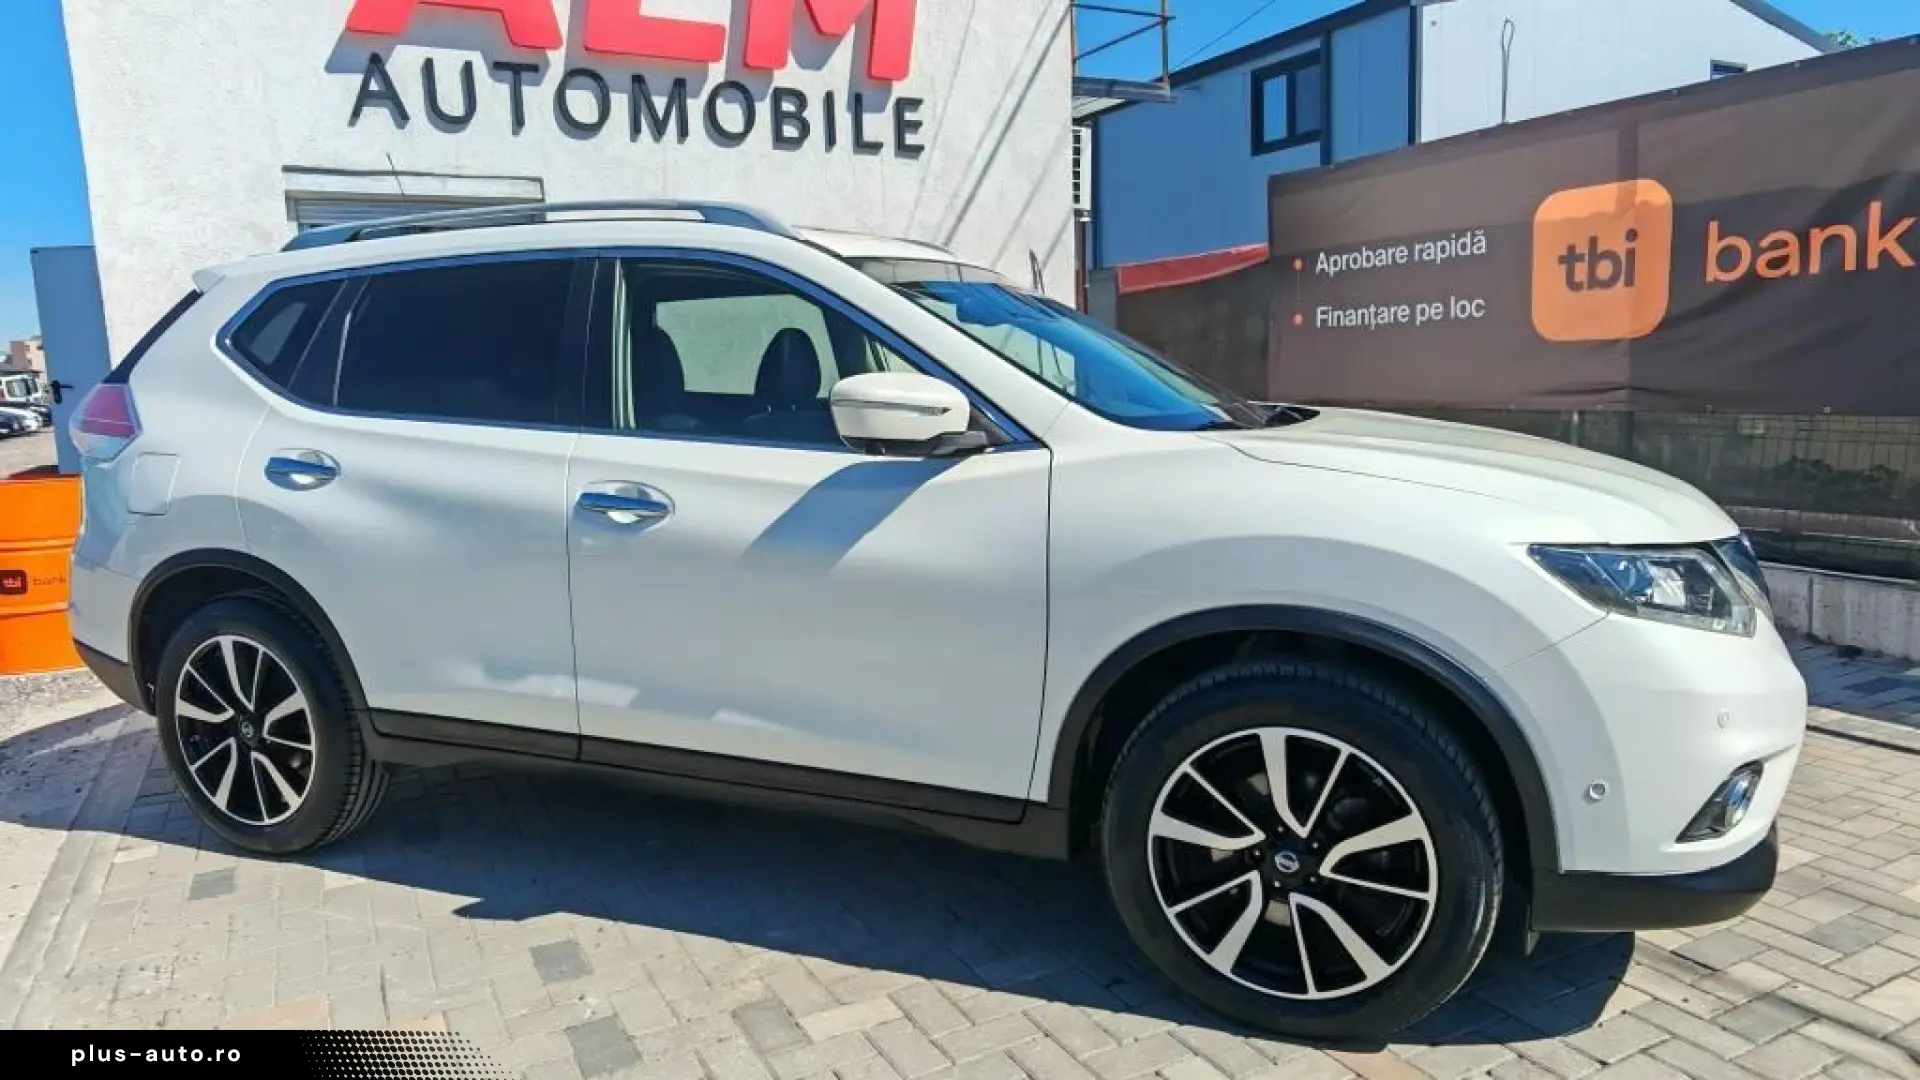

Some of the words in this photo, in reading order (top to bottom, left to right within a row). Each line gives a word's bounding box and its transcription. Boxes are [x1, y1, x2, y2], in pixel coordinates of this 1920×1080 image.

[349, 52, 926, 158] AUTOMOBILE
[1315, 245, 1409, 278] Aprobare
[1413, 229, 1487, 265] rapidă
[1557, 228, 1639, 292] tbi
[1706, 200, 1920, 284] bank
[1415, 302, 1443, 327] pe
[1450, 295, 1487, 320] loc
